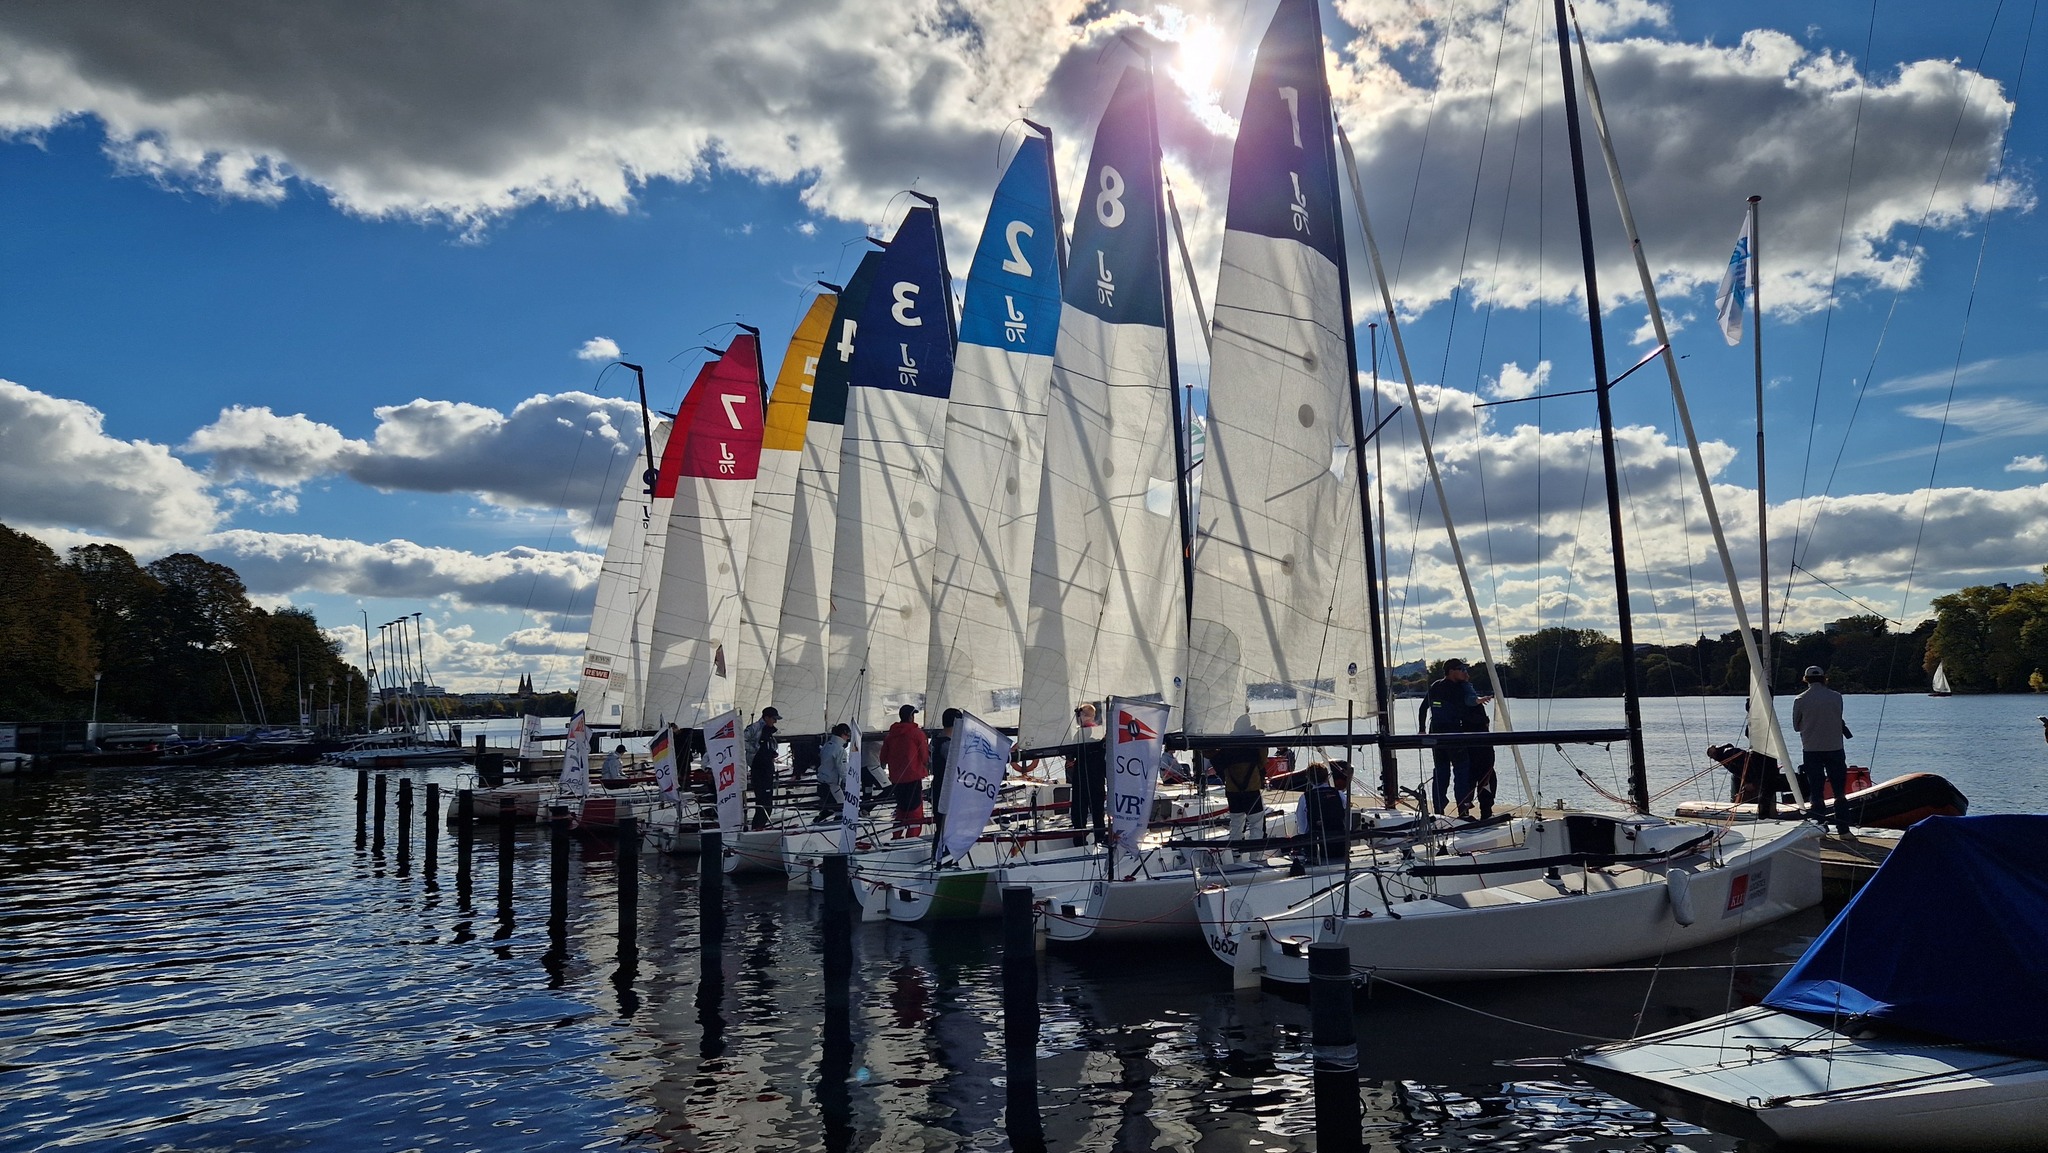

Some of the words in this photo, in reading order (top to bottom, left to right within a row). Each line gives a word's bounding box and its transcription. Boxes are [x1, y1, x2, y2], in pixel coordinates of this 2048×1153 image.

[1278, 86, 1304, 149] 1
[1096, 165, 1126, 228] 8
[585, 669, 609, 678] REWE
[956, 766, 996, 800] YCBG
